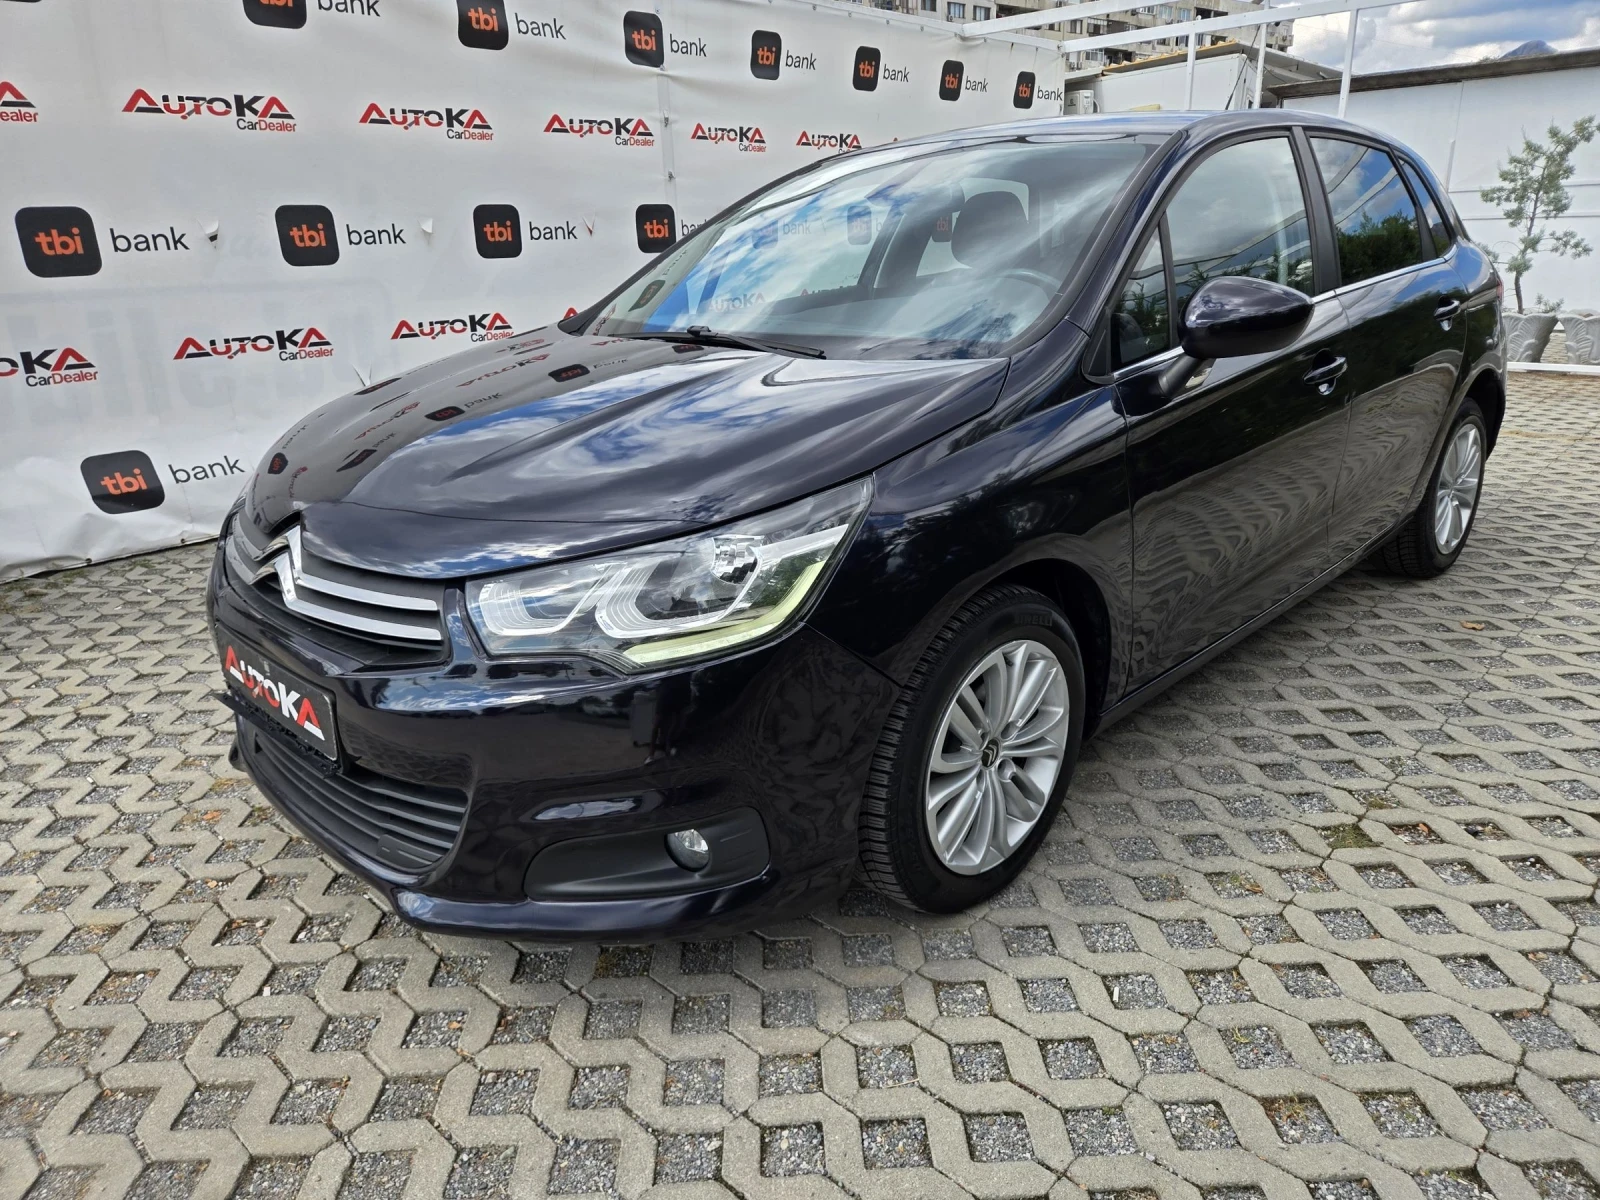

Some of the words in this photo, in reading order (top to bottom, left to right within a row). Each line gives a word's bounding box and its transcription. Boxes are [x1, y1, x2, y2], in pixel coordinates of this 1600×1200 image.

[468, 8, 499, 31] tbi
[514, 13, 566, 40] bank
[632, 30, 656, 50] tbi
[669, 34, 707, 57] bank
[757, 47, 776, 66] tbi
[785, 50, 817, 70] bank
[858, 60, 875, 79] tbi
[882, 64, 910, 83] bank
[944, 73, 960, 90] tbi
[965, 76, 989, 93] bank
[1018, 83, 1031, 99] tbi
[1037, 86, 1063, 102] bank
[0, 109, 39, 122] ealer
[236, 118, 297, 132] CarDealer
[446, 129, 494, 141] CarDealer
[614, 136, 655, 147] CarDealer
[738, 143, 766, 153] CarDealer
[289, 223, 327, 248] tbi
[346, 223, 407, 246] bank
[483, 220, 512, 242] tbi
[529, 221, 578, 241] bank
[644, 218, 669, 238] tbi
[681, 218, 707, 237] ba
[35, 227, 84, 256] tbi
[109, 226, 190, 253] bank
[0, 347, 96, 378] OKA
[279, 347, 335, 361] CarDealer
[25, 368, 99, 387] CarDealer
[101, 468, 148, 495] tbi
[168, 455, 245, 484] bank
